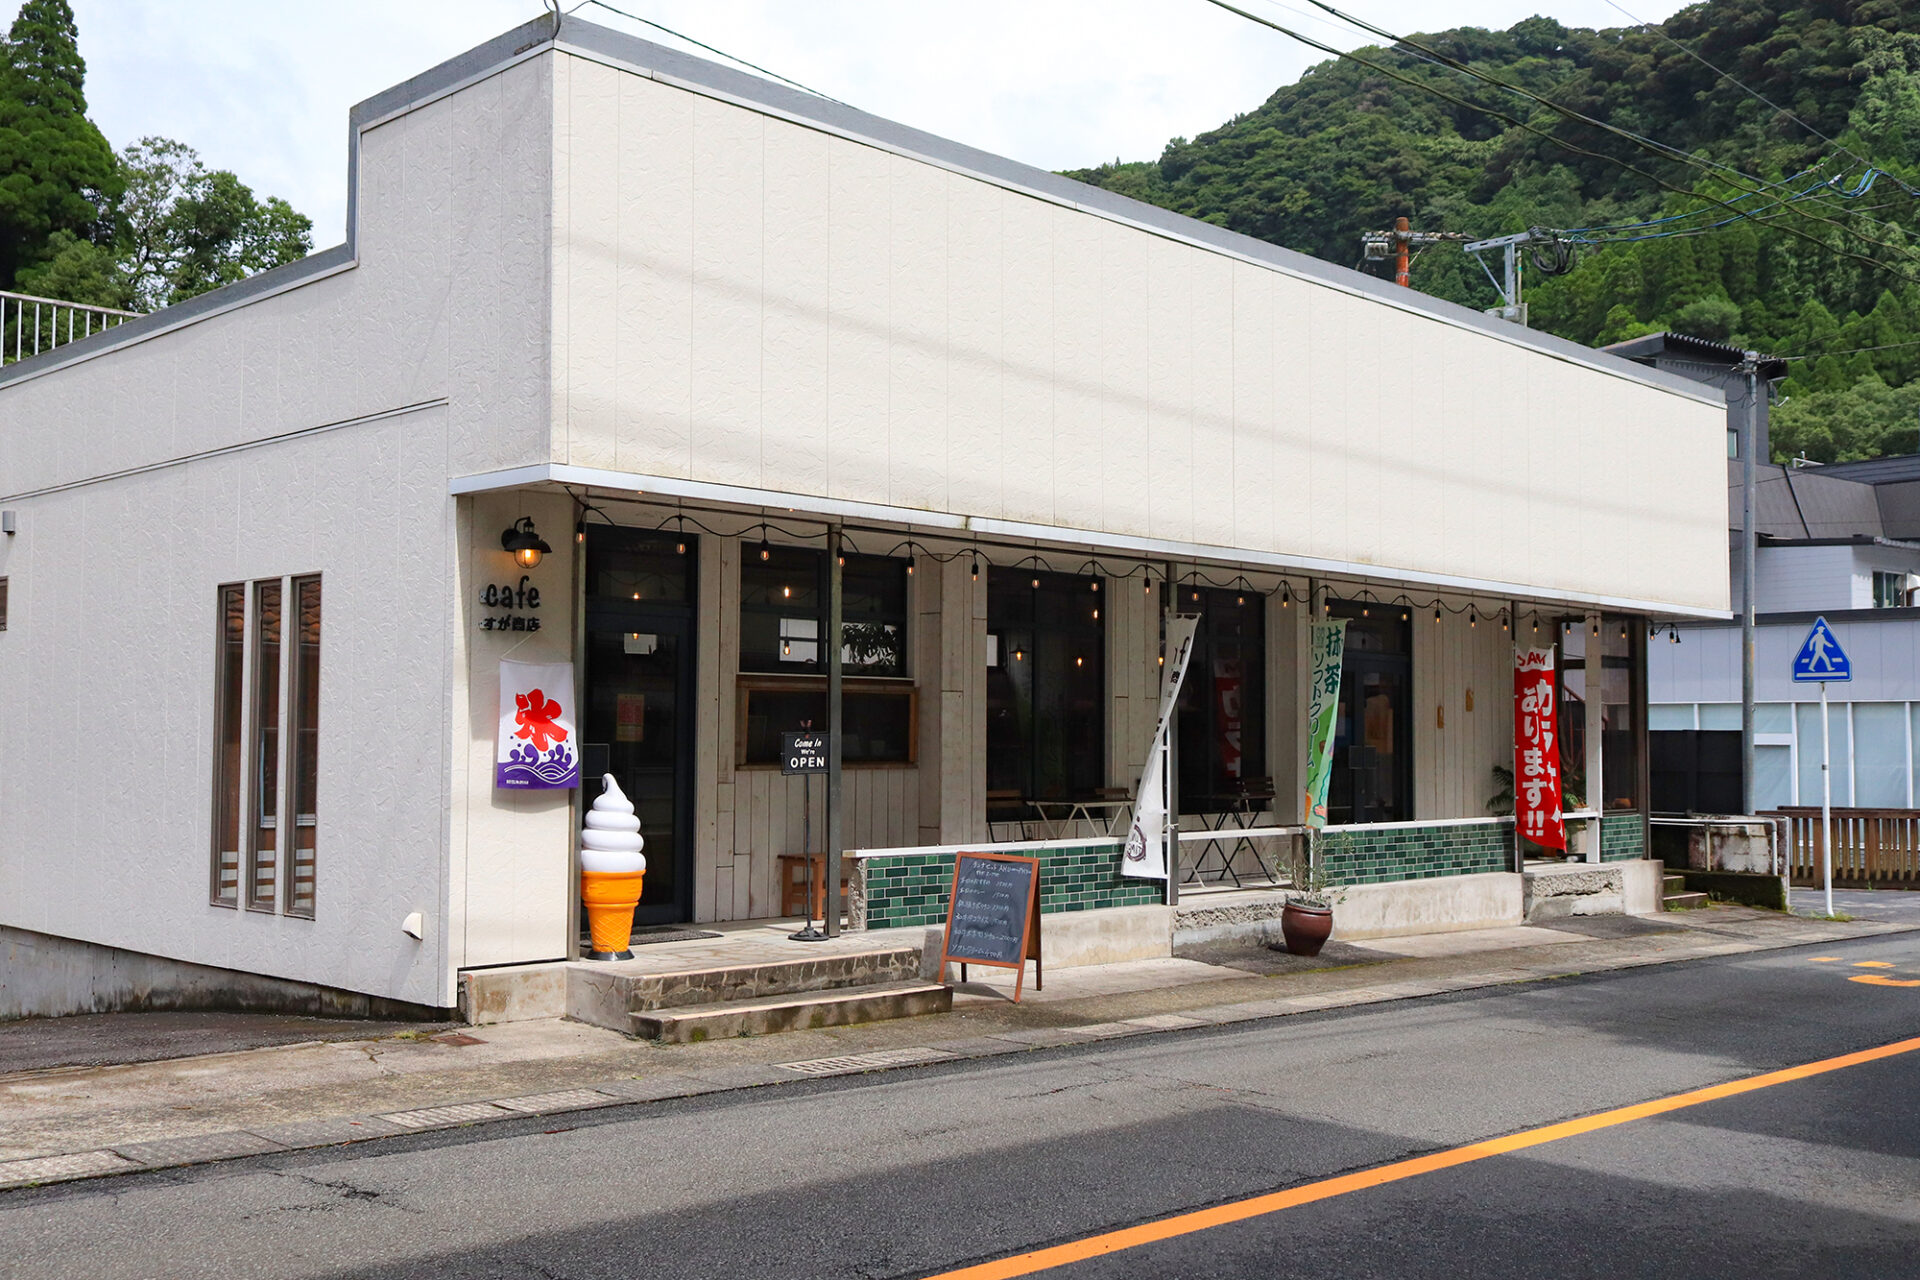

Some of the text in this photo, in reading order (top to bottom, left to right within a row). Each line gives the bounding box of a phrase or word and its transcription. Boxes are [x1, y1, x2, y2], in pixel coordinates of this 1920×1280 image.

[486, 575, 540, 609] cafe
[484, 614, 541, 632] すが商店
[1325, 625, 1343, 695] 抹茶
[513, 688, 568, 752] 氷
[794, 738, 822, 748] Come In
[790, 757, 825, 768] OPEN
